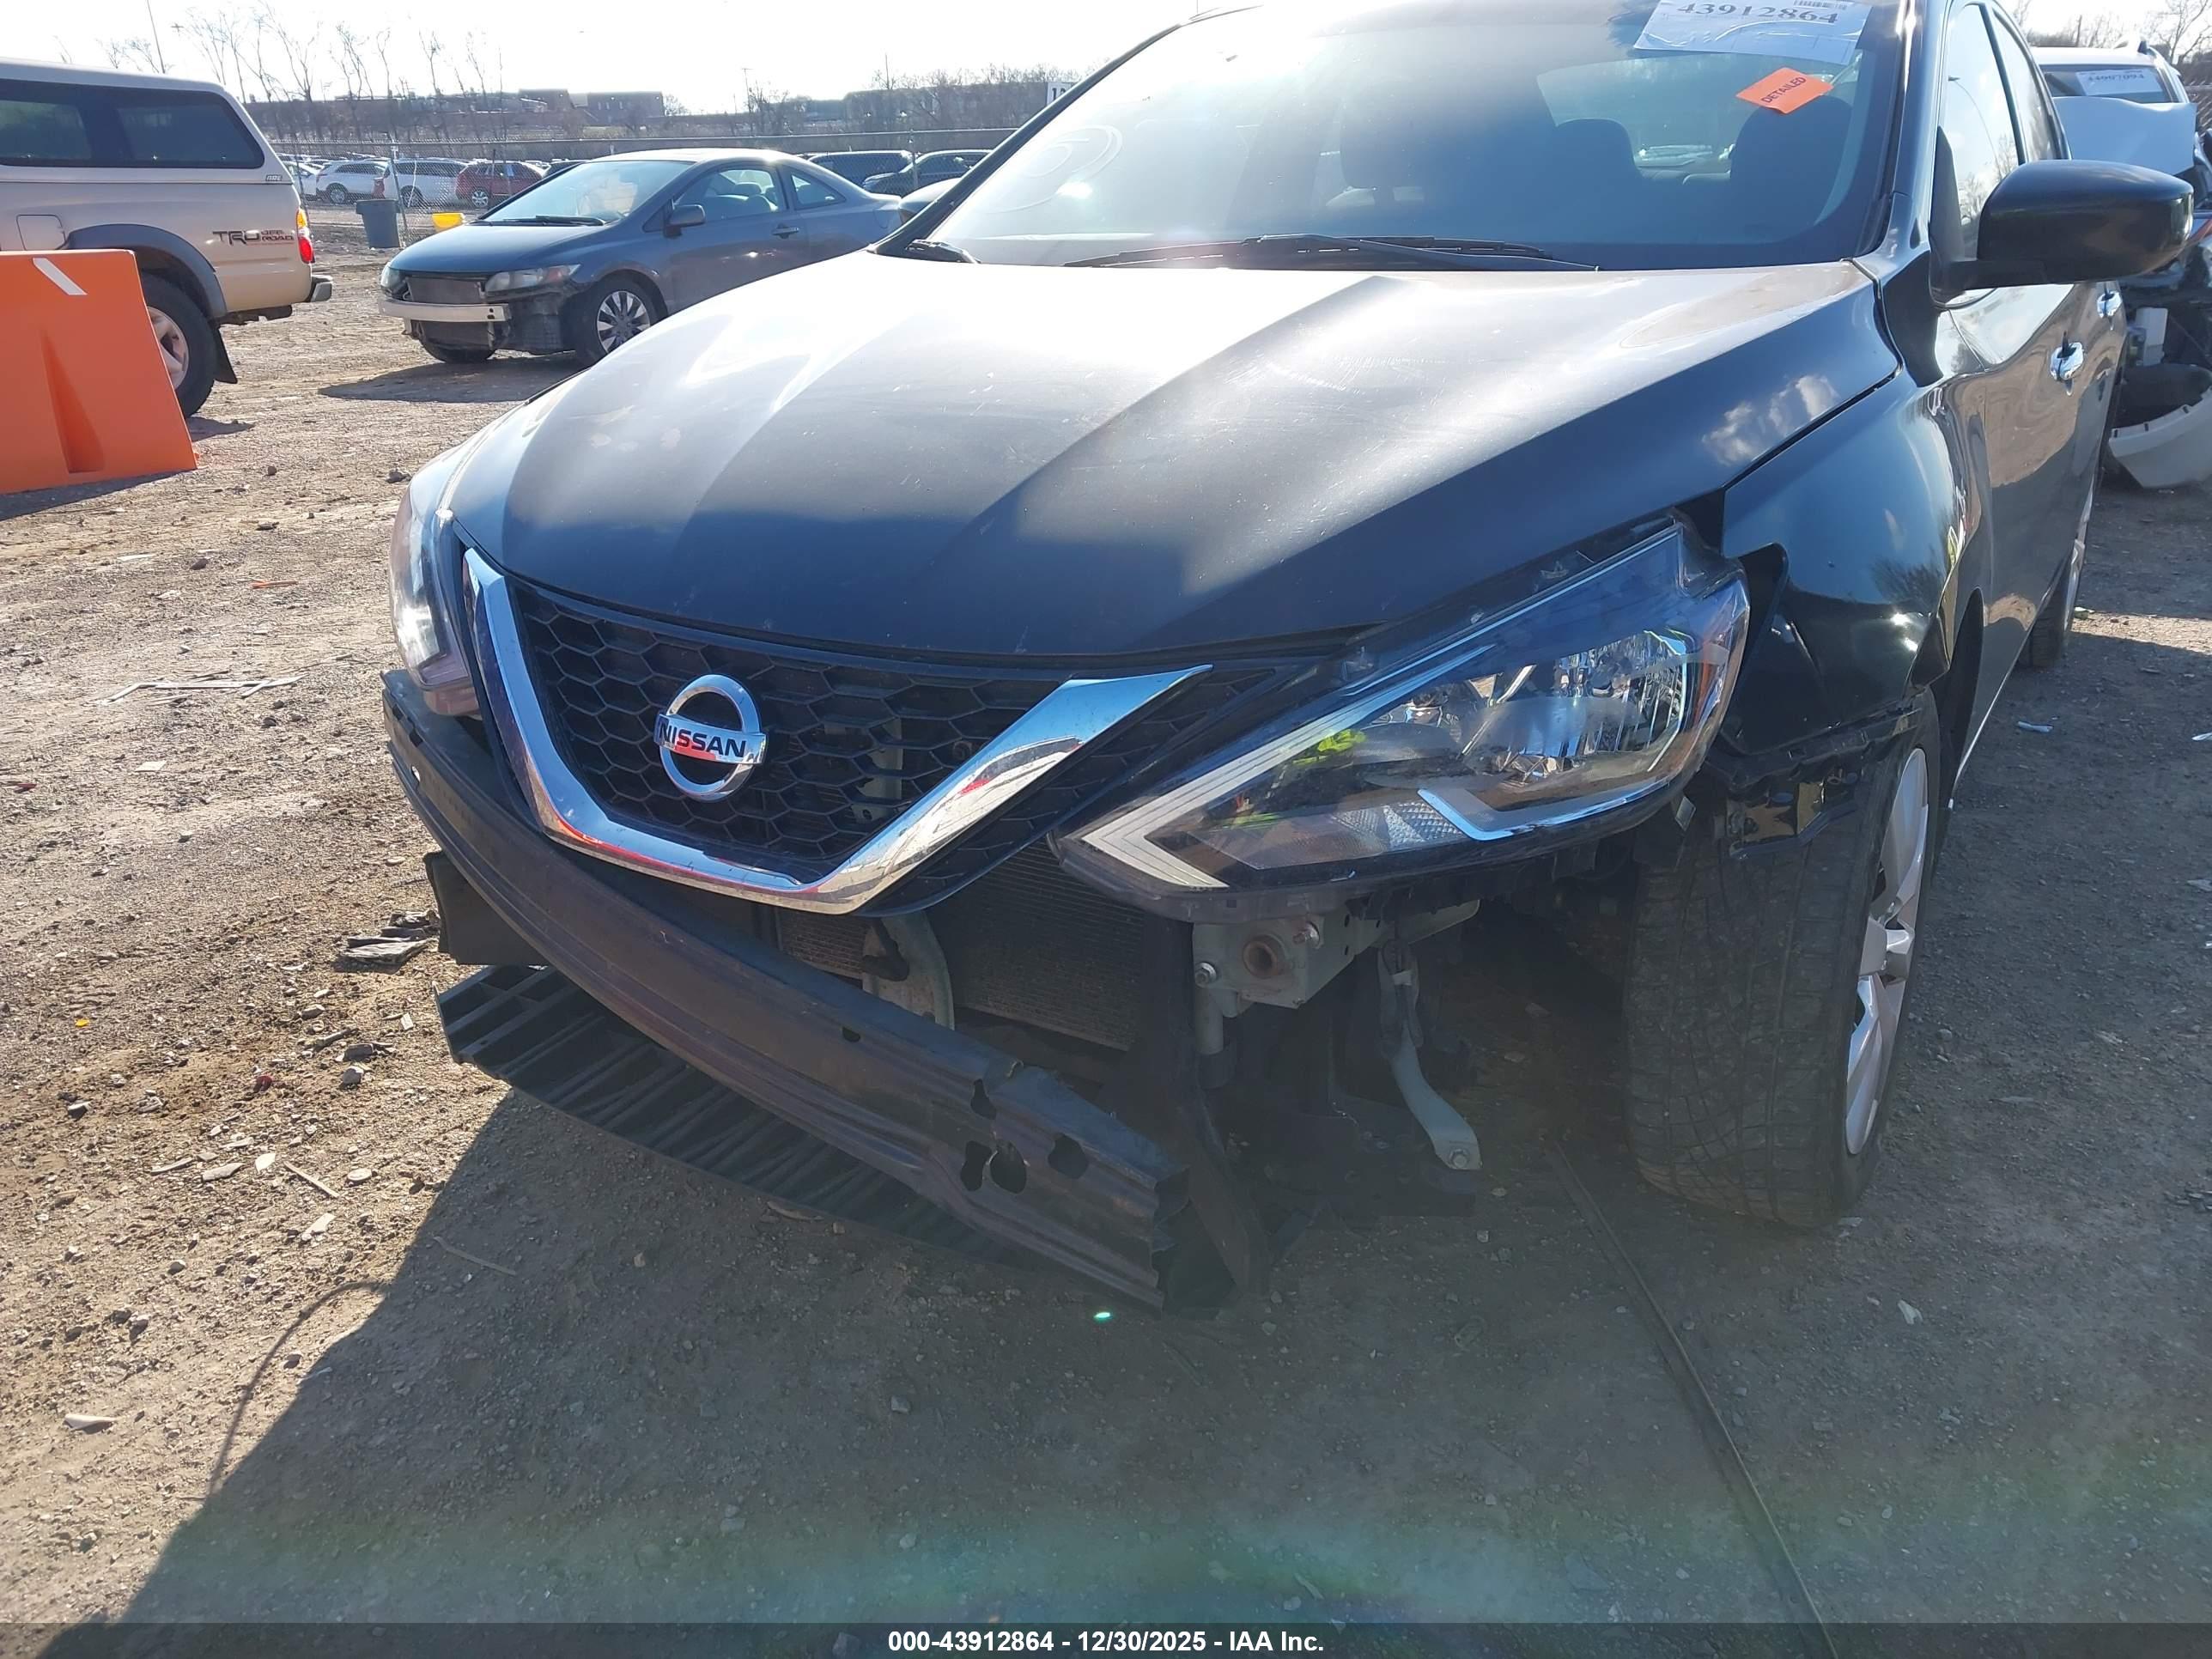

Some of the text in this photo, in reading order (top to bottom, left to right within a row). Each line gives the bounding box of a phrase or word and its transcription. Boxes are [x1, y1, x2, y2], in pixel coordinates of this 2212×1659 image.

[1677, 3, 1838, 24] 43912864
[1760, 76, 1807, 103] DETAILED
[212, 229, 260, 245] TRD
[659, 719, 746, 757] NISSAN
